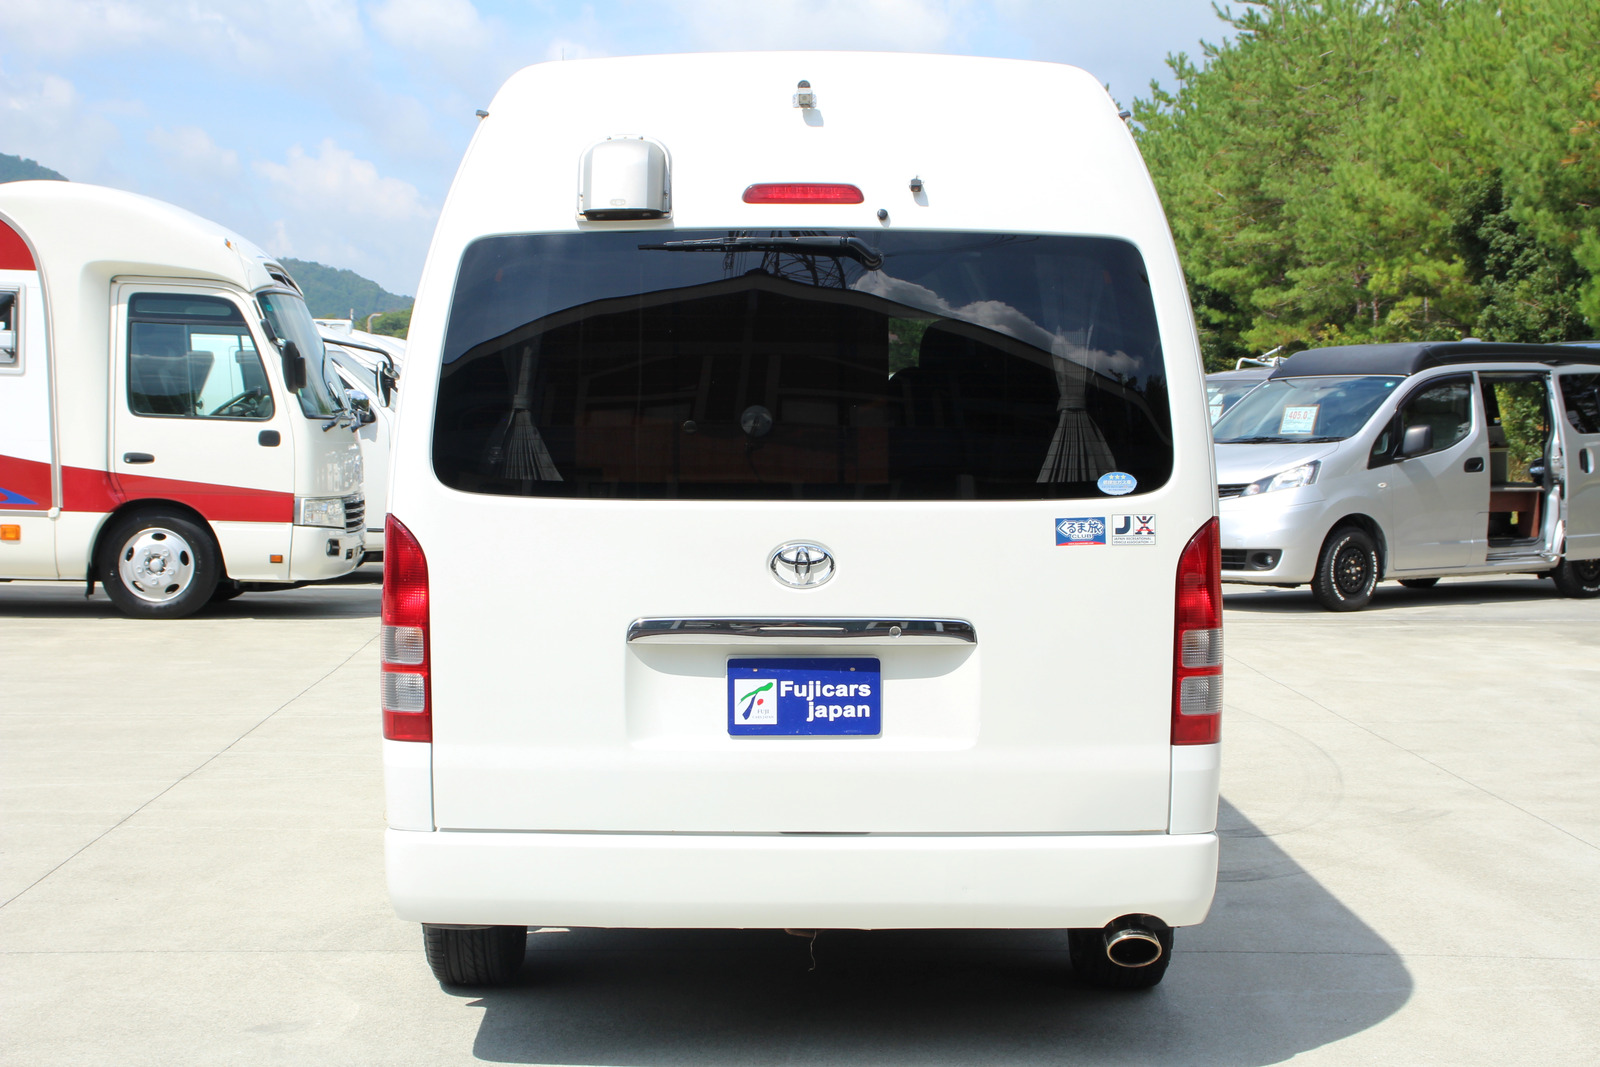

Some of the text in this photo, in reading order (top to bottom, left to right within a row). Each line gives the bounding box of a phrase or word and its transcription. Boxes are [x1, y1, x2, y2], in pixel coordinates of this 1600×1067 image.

[1058, 520, 1103, 535] くるま旅
[780, 680, 871, 701] Fujicars
[806, 701, 870, 722] japan
